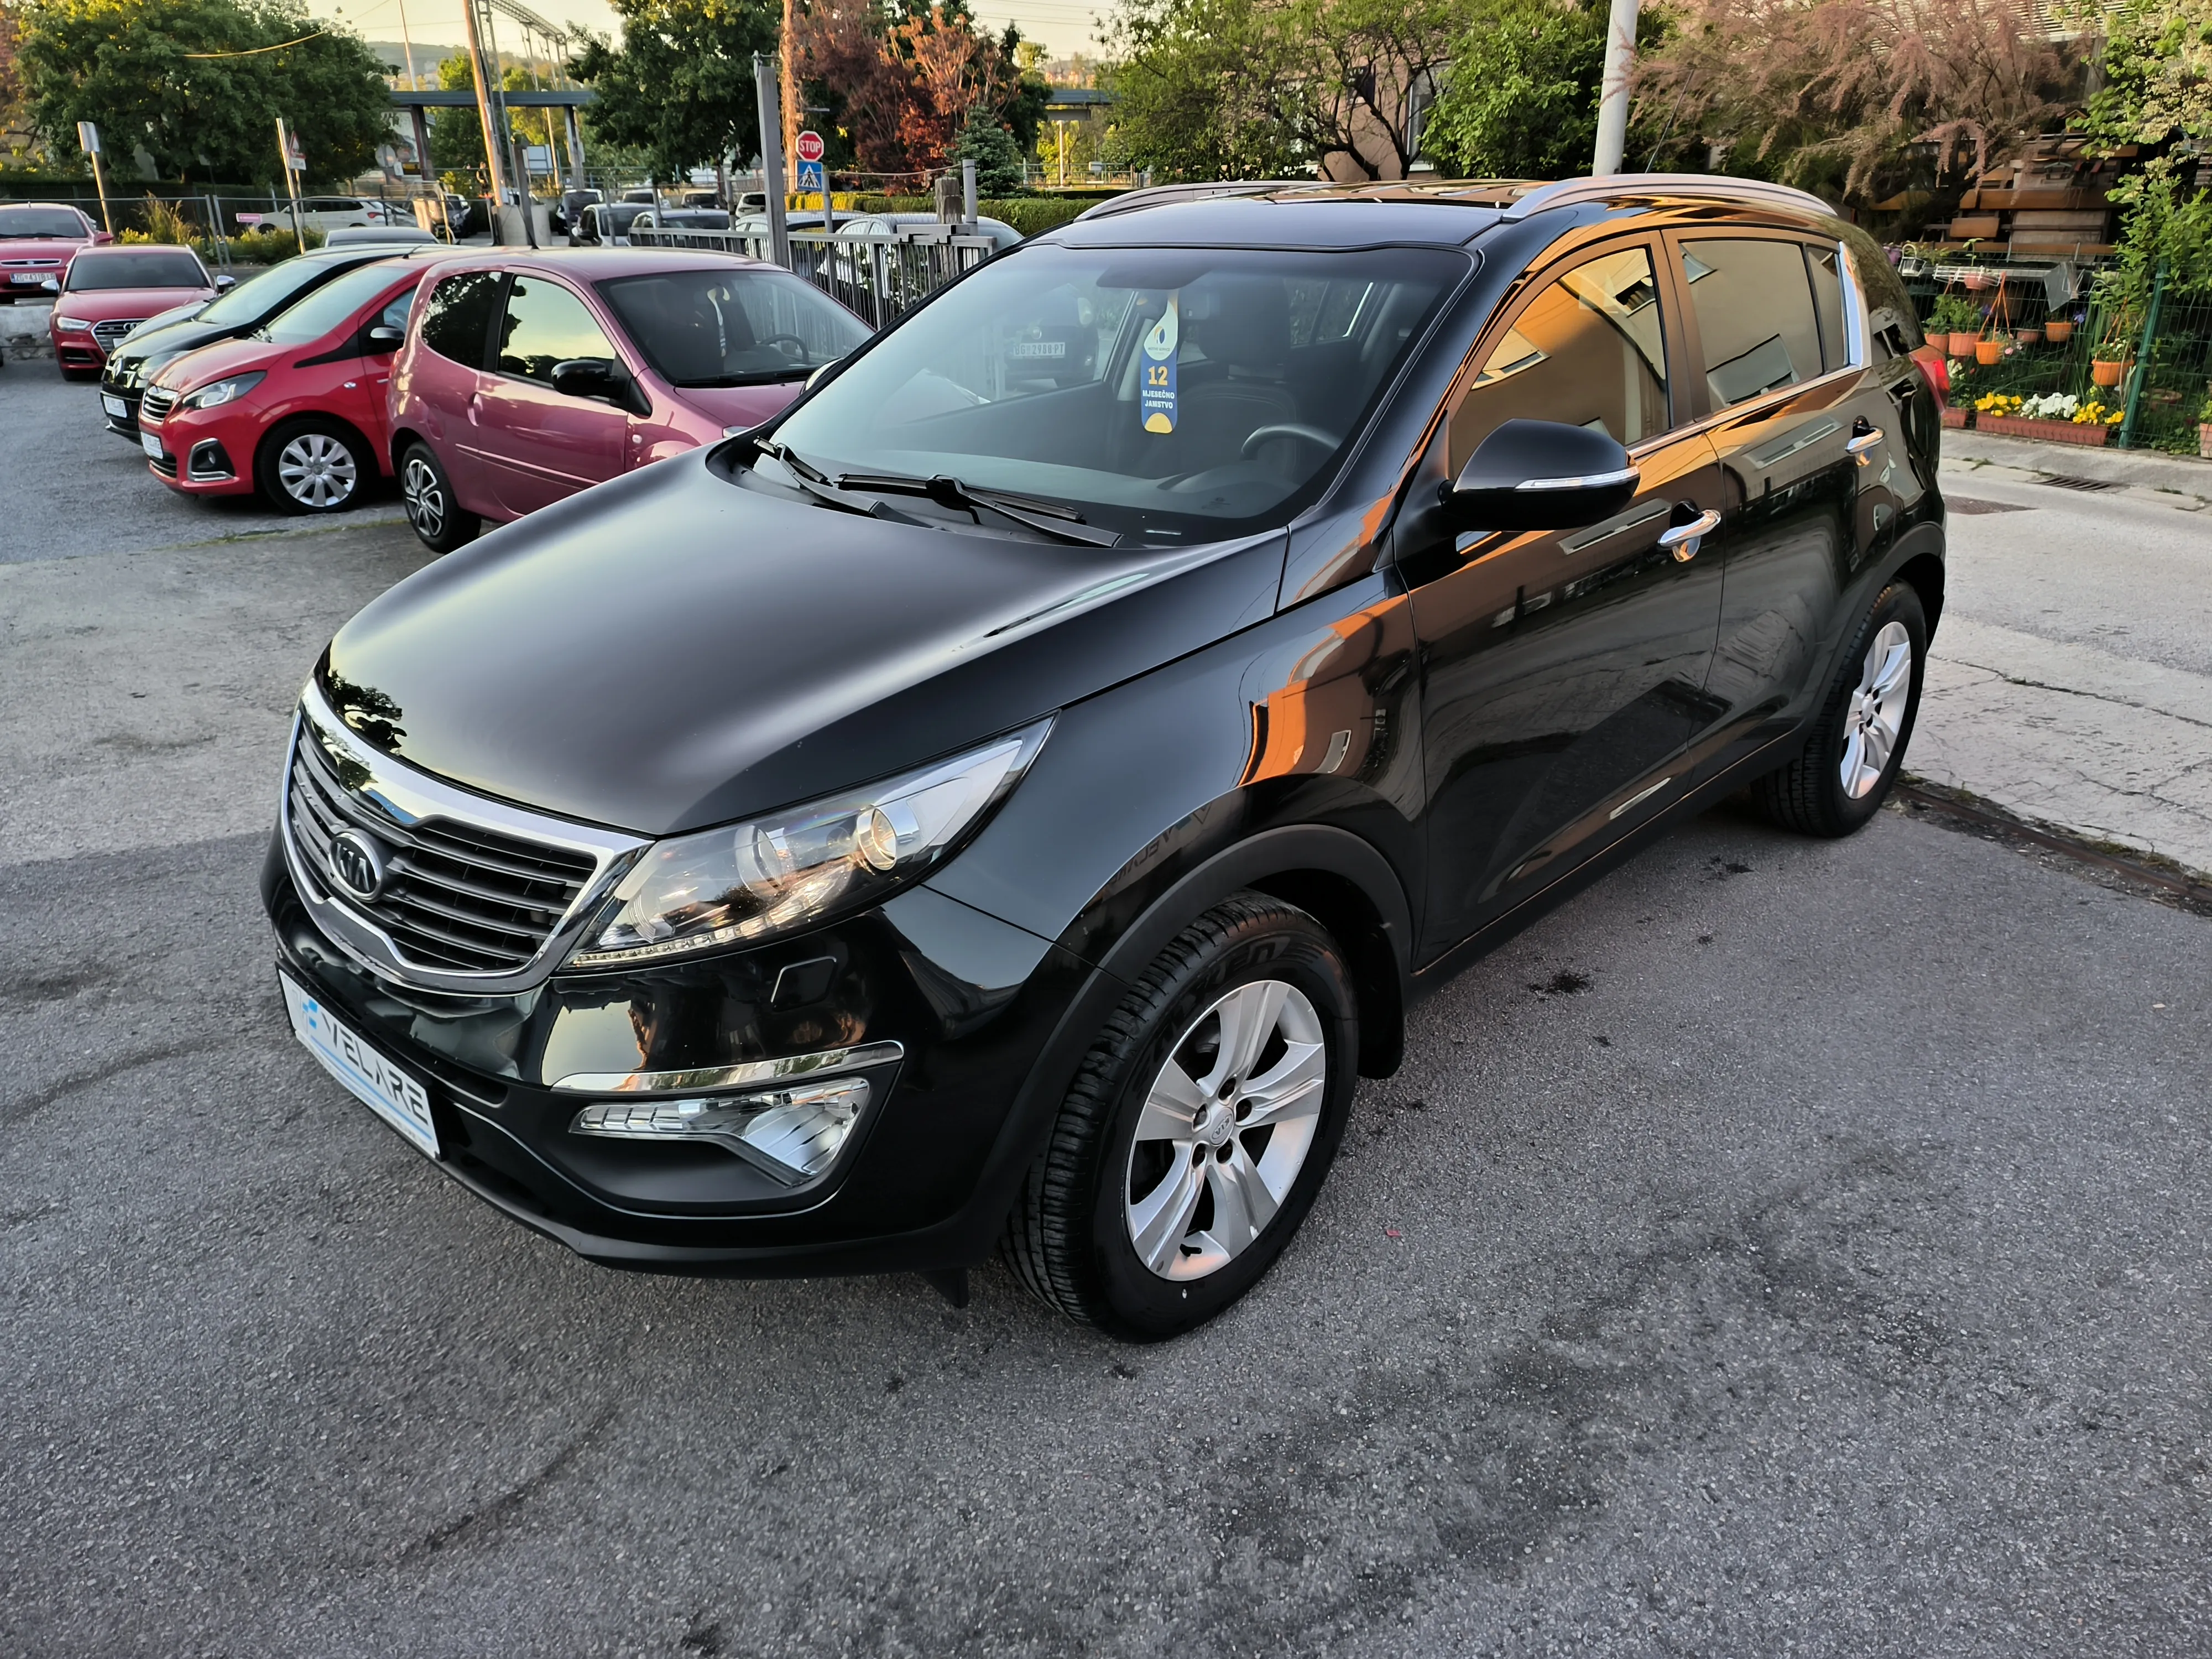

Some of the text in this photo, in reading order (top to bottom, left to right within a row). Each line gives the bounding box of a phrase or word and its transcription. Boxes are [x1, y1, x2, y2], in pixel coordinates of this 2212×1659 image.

[799, 140, 821, 153] STOP
[1149, 366, 1168, 385] 12
[1142, 389, 1175, 399] MJESEČNO
[1145, 400, 1173, 409] JAMSTVO
[336, 842, 370, 891] KIA
[1214, 1117, 1230, 1136] KIA
